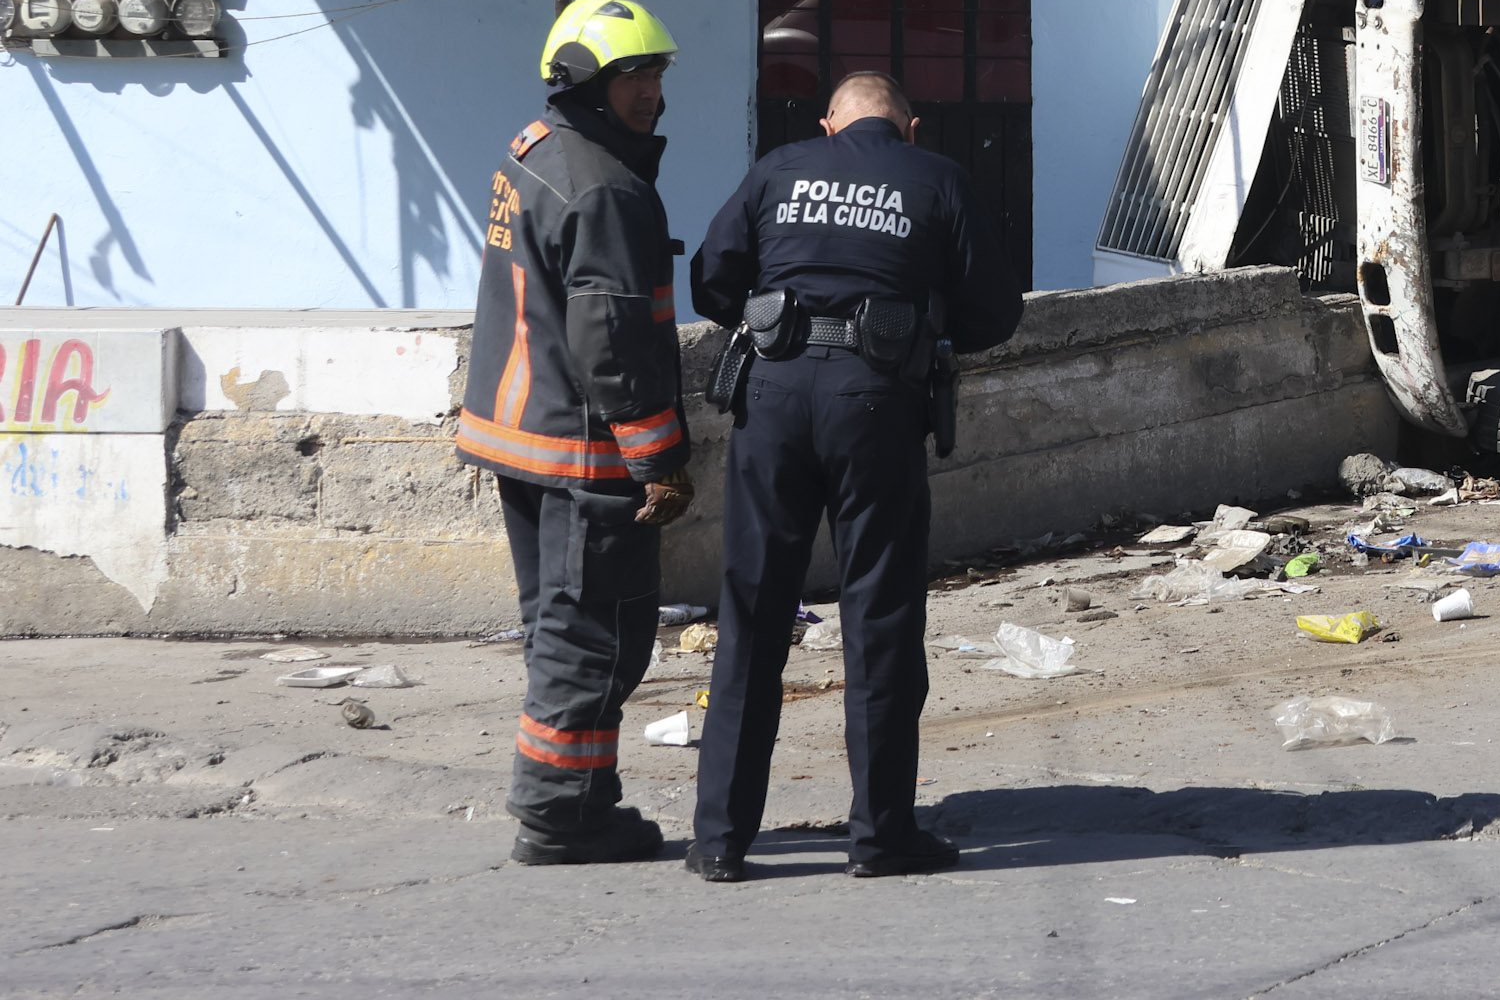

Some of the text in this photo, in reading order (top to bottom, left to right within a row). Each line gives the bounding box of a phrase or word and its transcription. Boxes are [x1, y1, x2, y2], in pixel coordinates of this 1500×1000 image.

[1367, 98, 1379, 178] XE-8466-C
[791, 180, 903, 212] POLICÍA
[776, 202, 912, 238] DE LA CIUDAD
